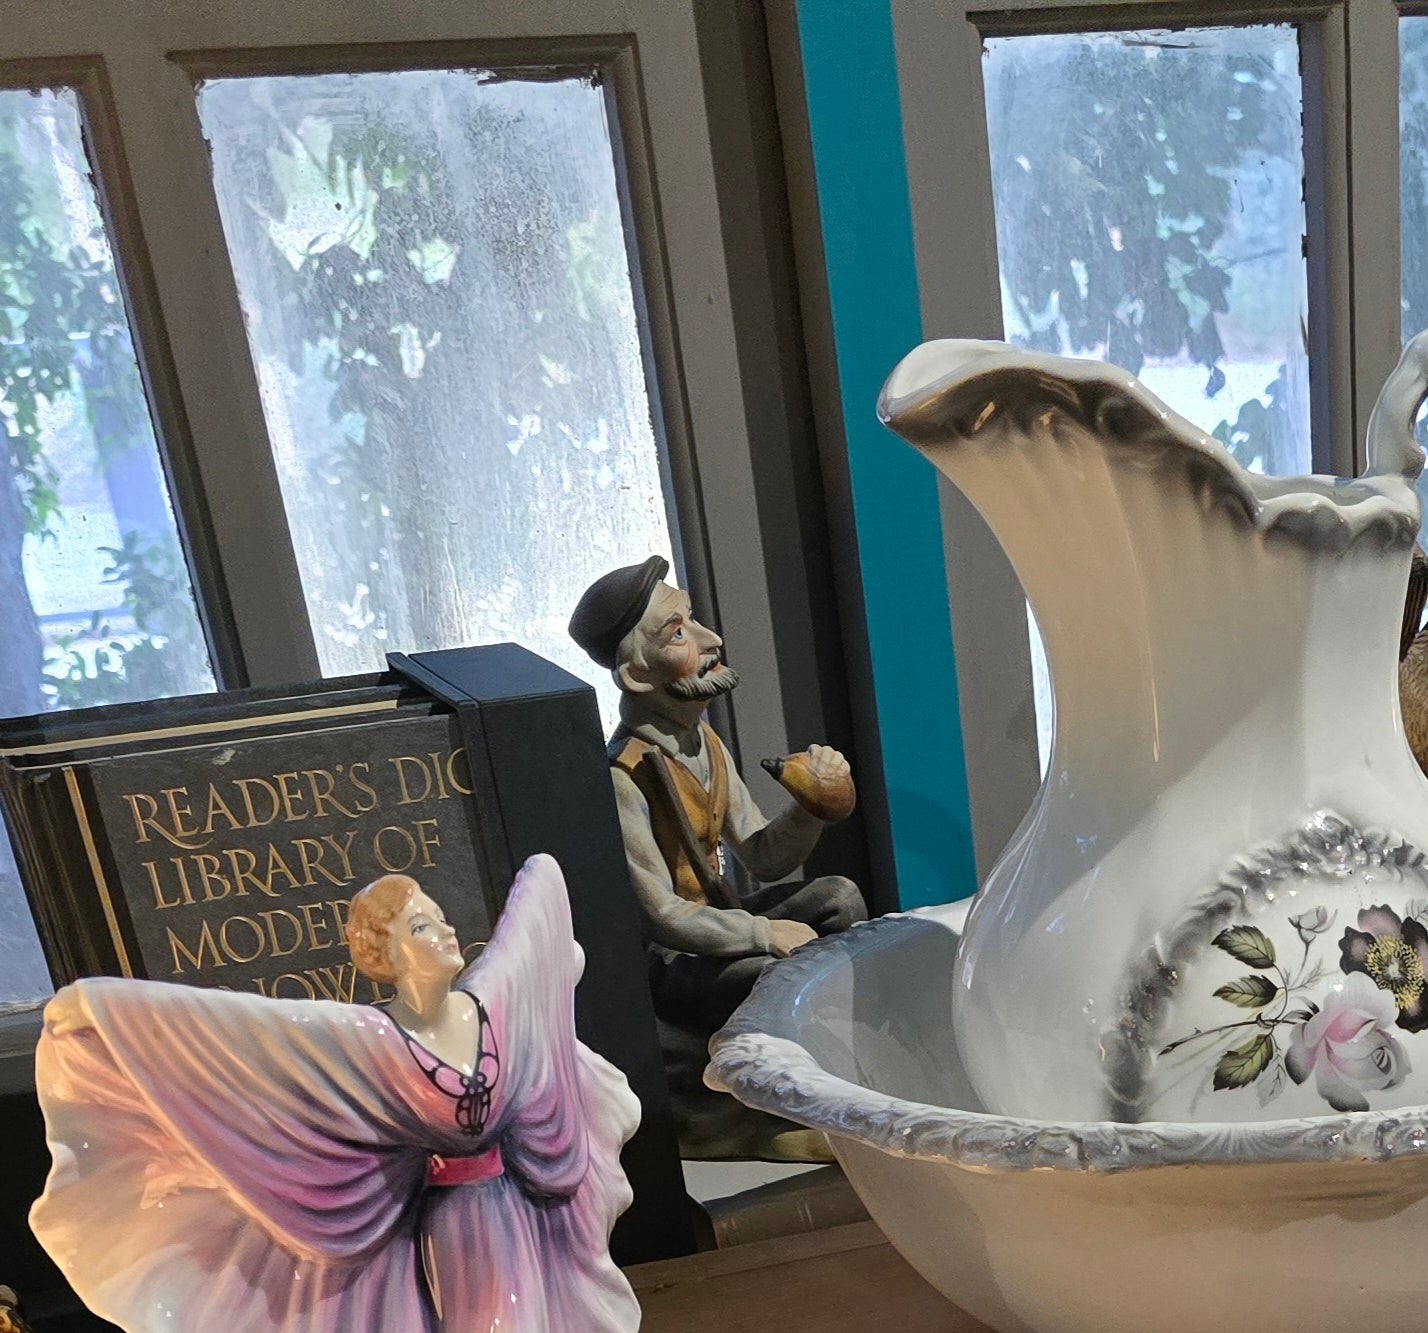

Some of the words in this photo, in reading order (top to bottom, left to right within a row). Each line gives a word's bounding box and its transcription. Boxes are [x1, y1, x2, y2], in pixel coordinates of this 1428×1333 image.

[122, 762, 378, 850] READER'S
[141, 830, 359, 911] LIBRARY
[373, 818, 441, 873] OF
